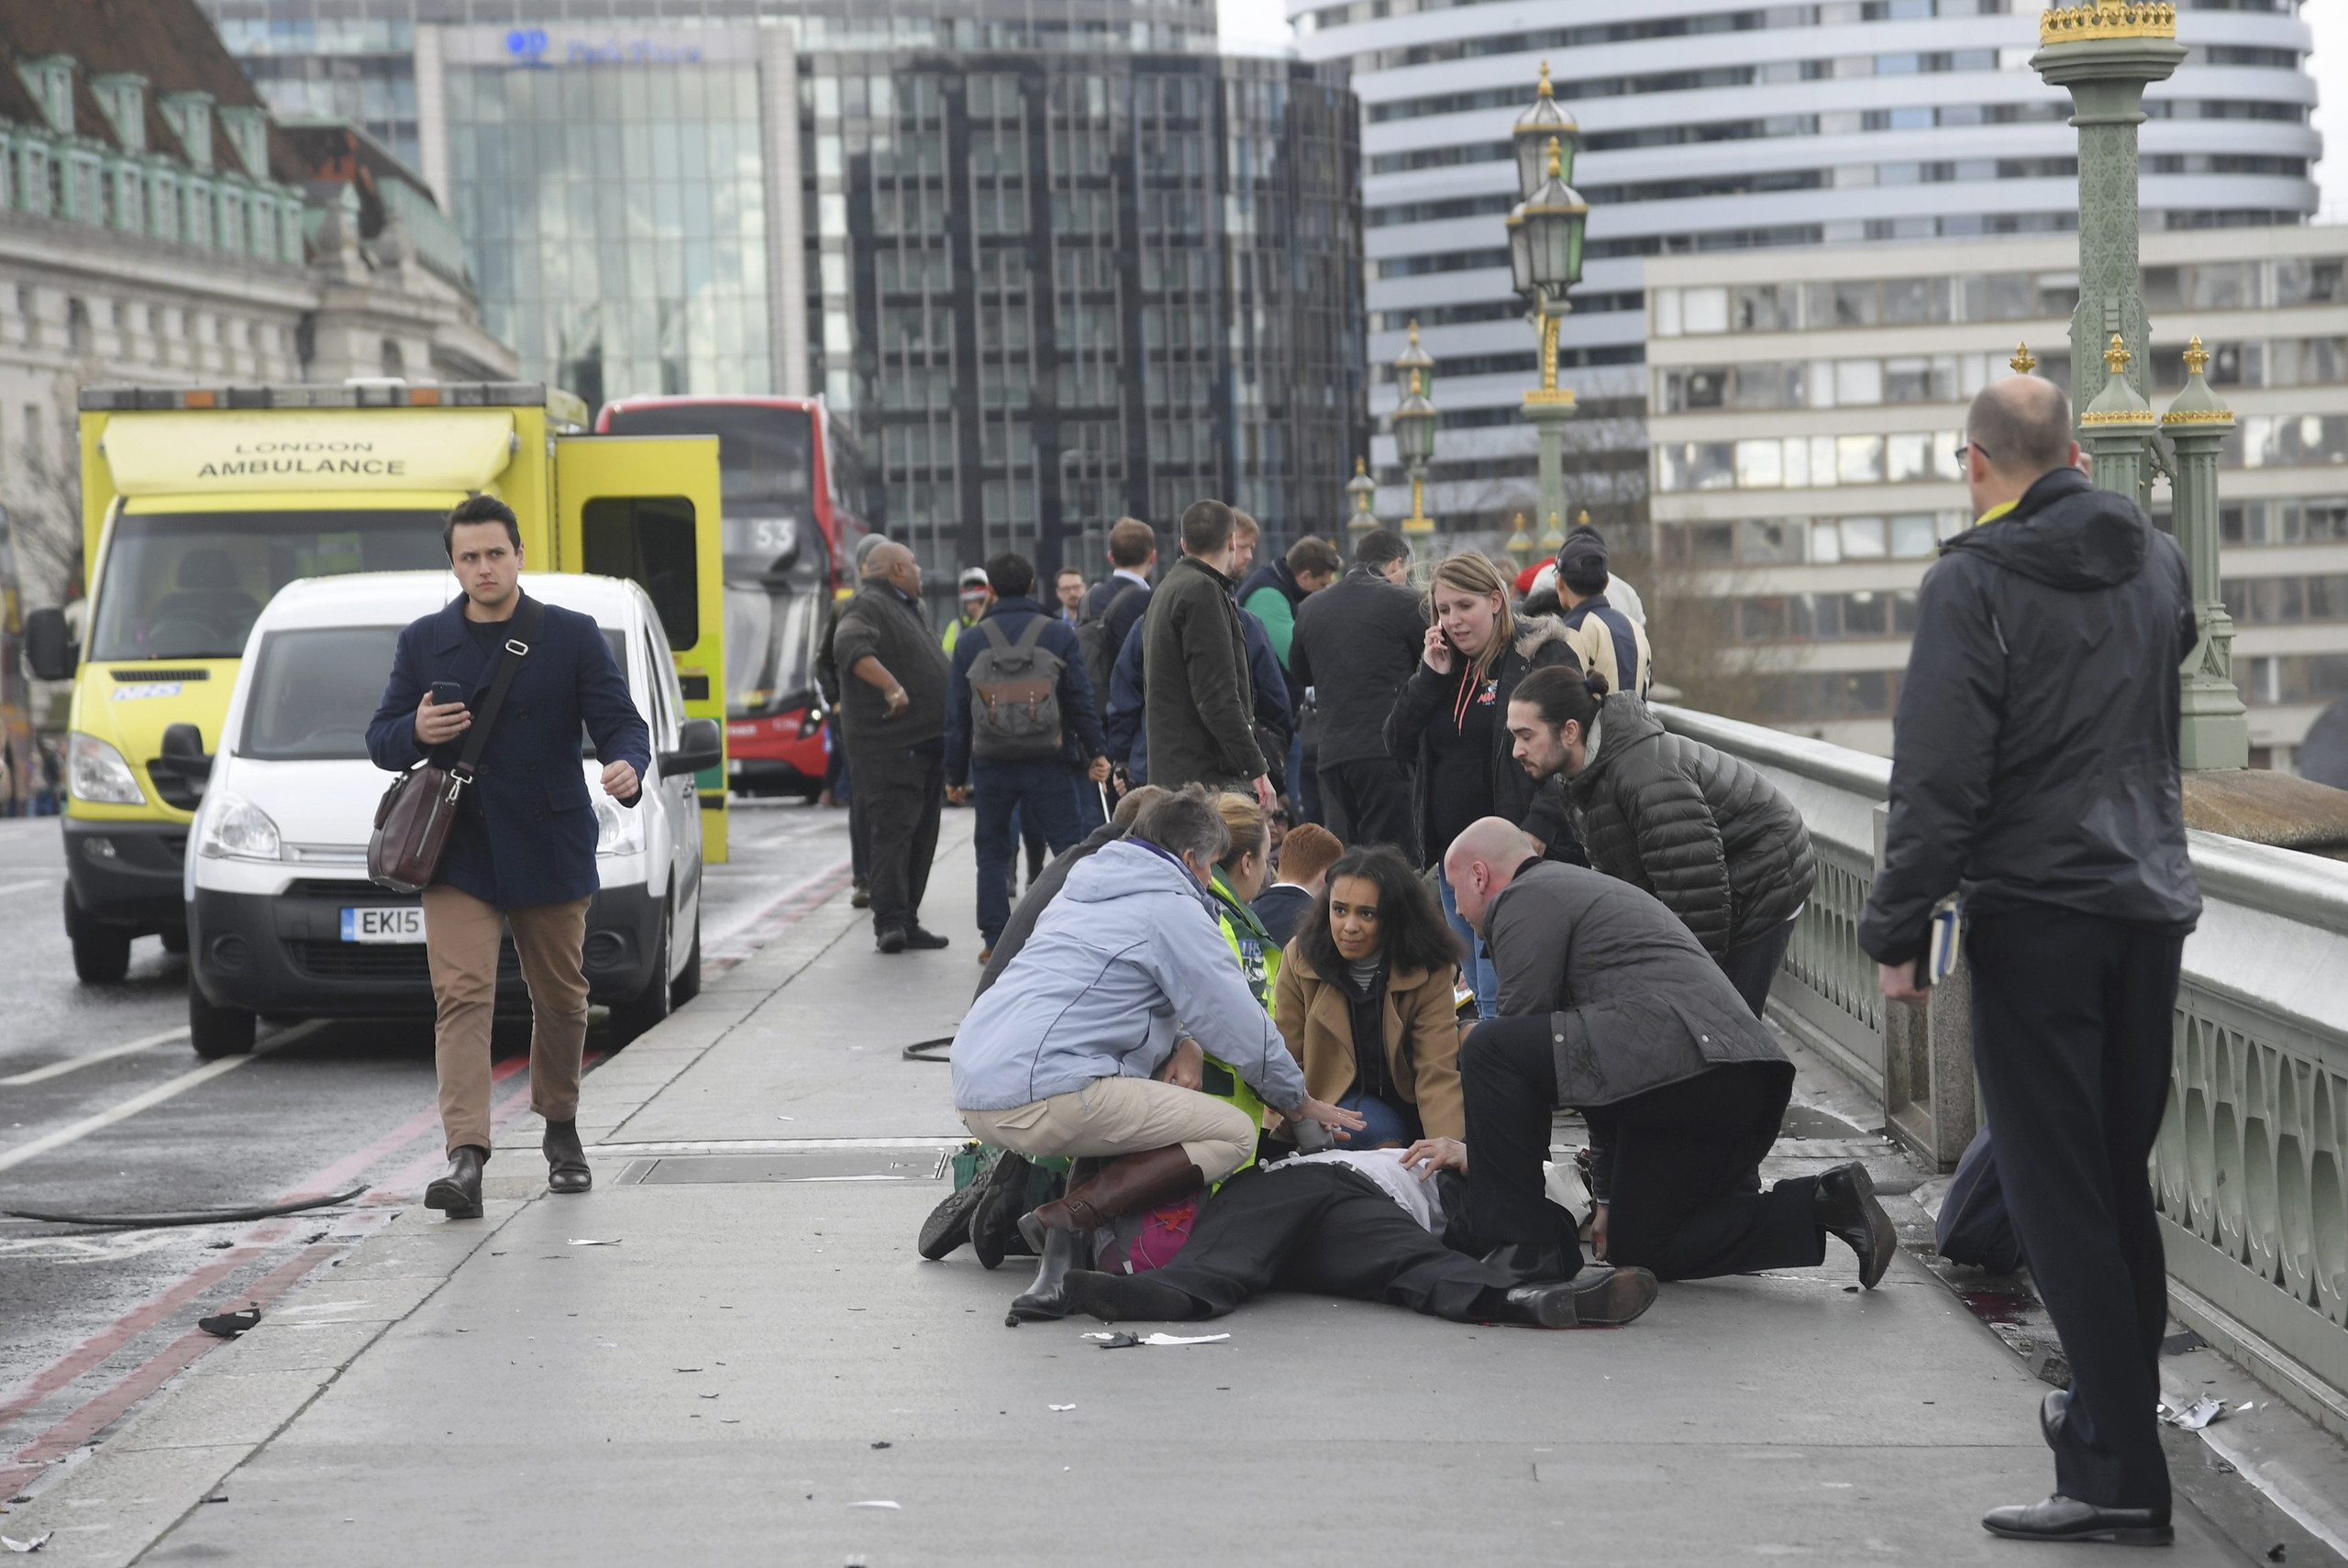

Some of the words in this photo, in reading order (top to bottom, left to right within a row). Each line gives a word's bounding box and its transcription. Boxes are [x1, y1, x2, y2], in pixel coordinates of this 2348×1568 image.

[235, 441, 373, 454] LONDON
[197, 458, 405, 478] AMBULANCE
[756, 519, 793, 549] 53
[363, 911, 419, 933] EK15
